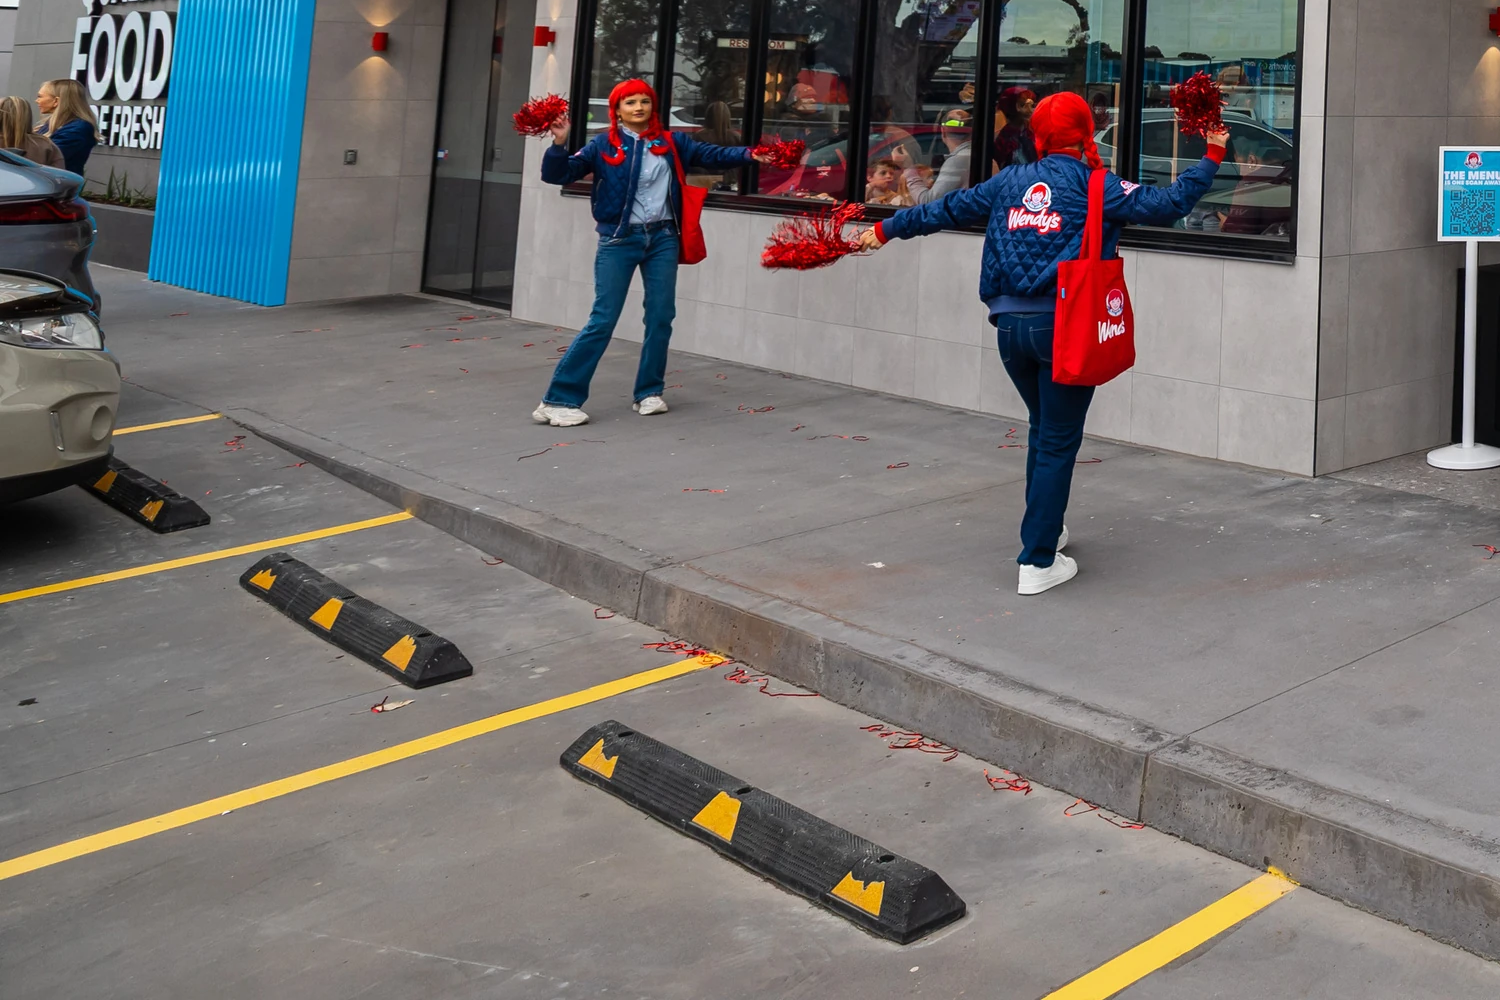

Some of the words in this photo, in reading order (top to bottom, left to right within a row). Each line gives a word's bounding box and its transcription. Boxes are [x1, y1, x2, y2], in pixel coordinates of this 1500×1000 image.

[70, 10, 173, 101] FOOD
[730, 39, 785, 49] RESOM
[109, 105, 166, 149] FRESH
[1443, 170, 1466, 180] THE
[1008, 208, 1061, 233] Wendy's
